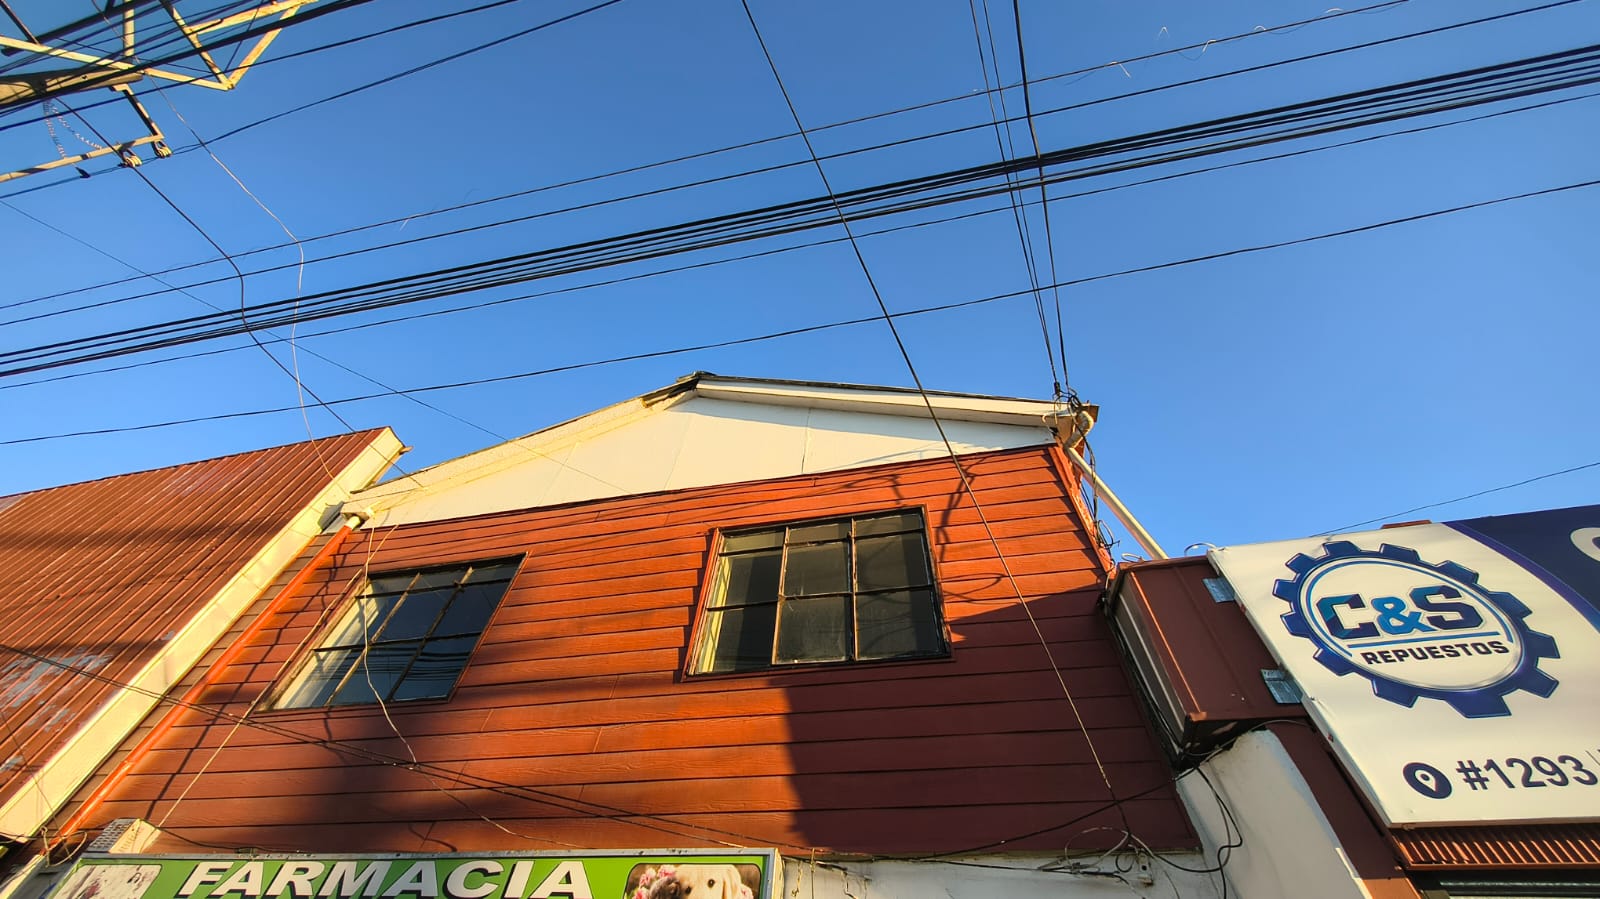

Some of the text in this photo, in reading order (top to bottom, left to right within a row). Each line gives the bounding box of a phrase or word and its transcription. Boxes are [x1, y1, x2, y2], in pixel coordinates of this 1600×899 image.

[1316, 585, 1483, 639] C&S
[1360, 641, 1510, 664] REPUESTOS
[1456, 755, 1598, 790] #1293
[178, 860, 593, 898] FARMACIA
